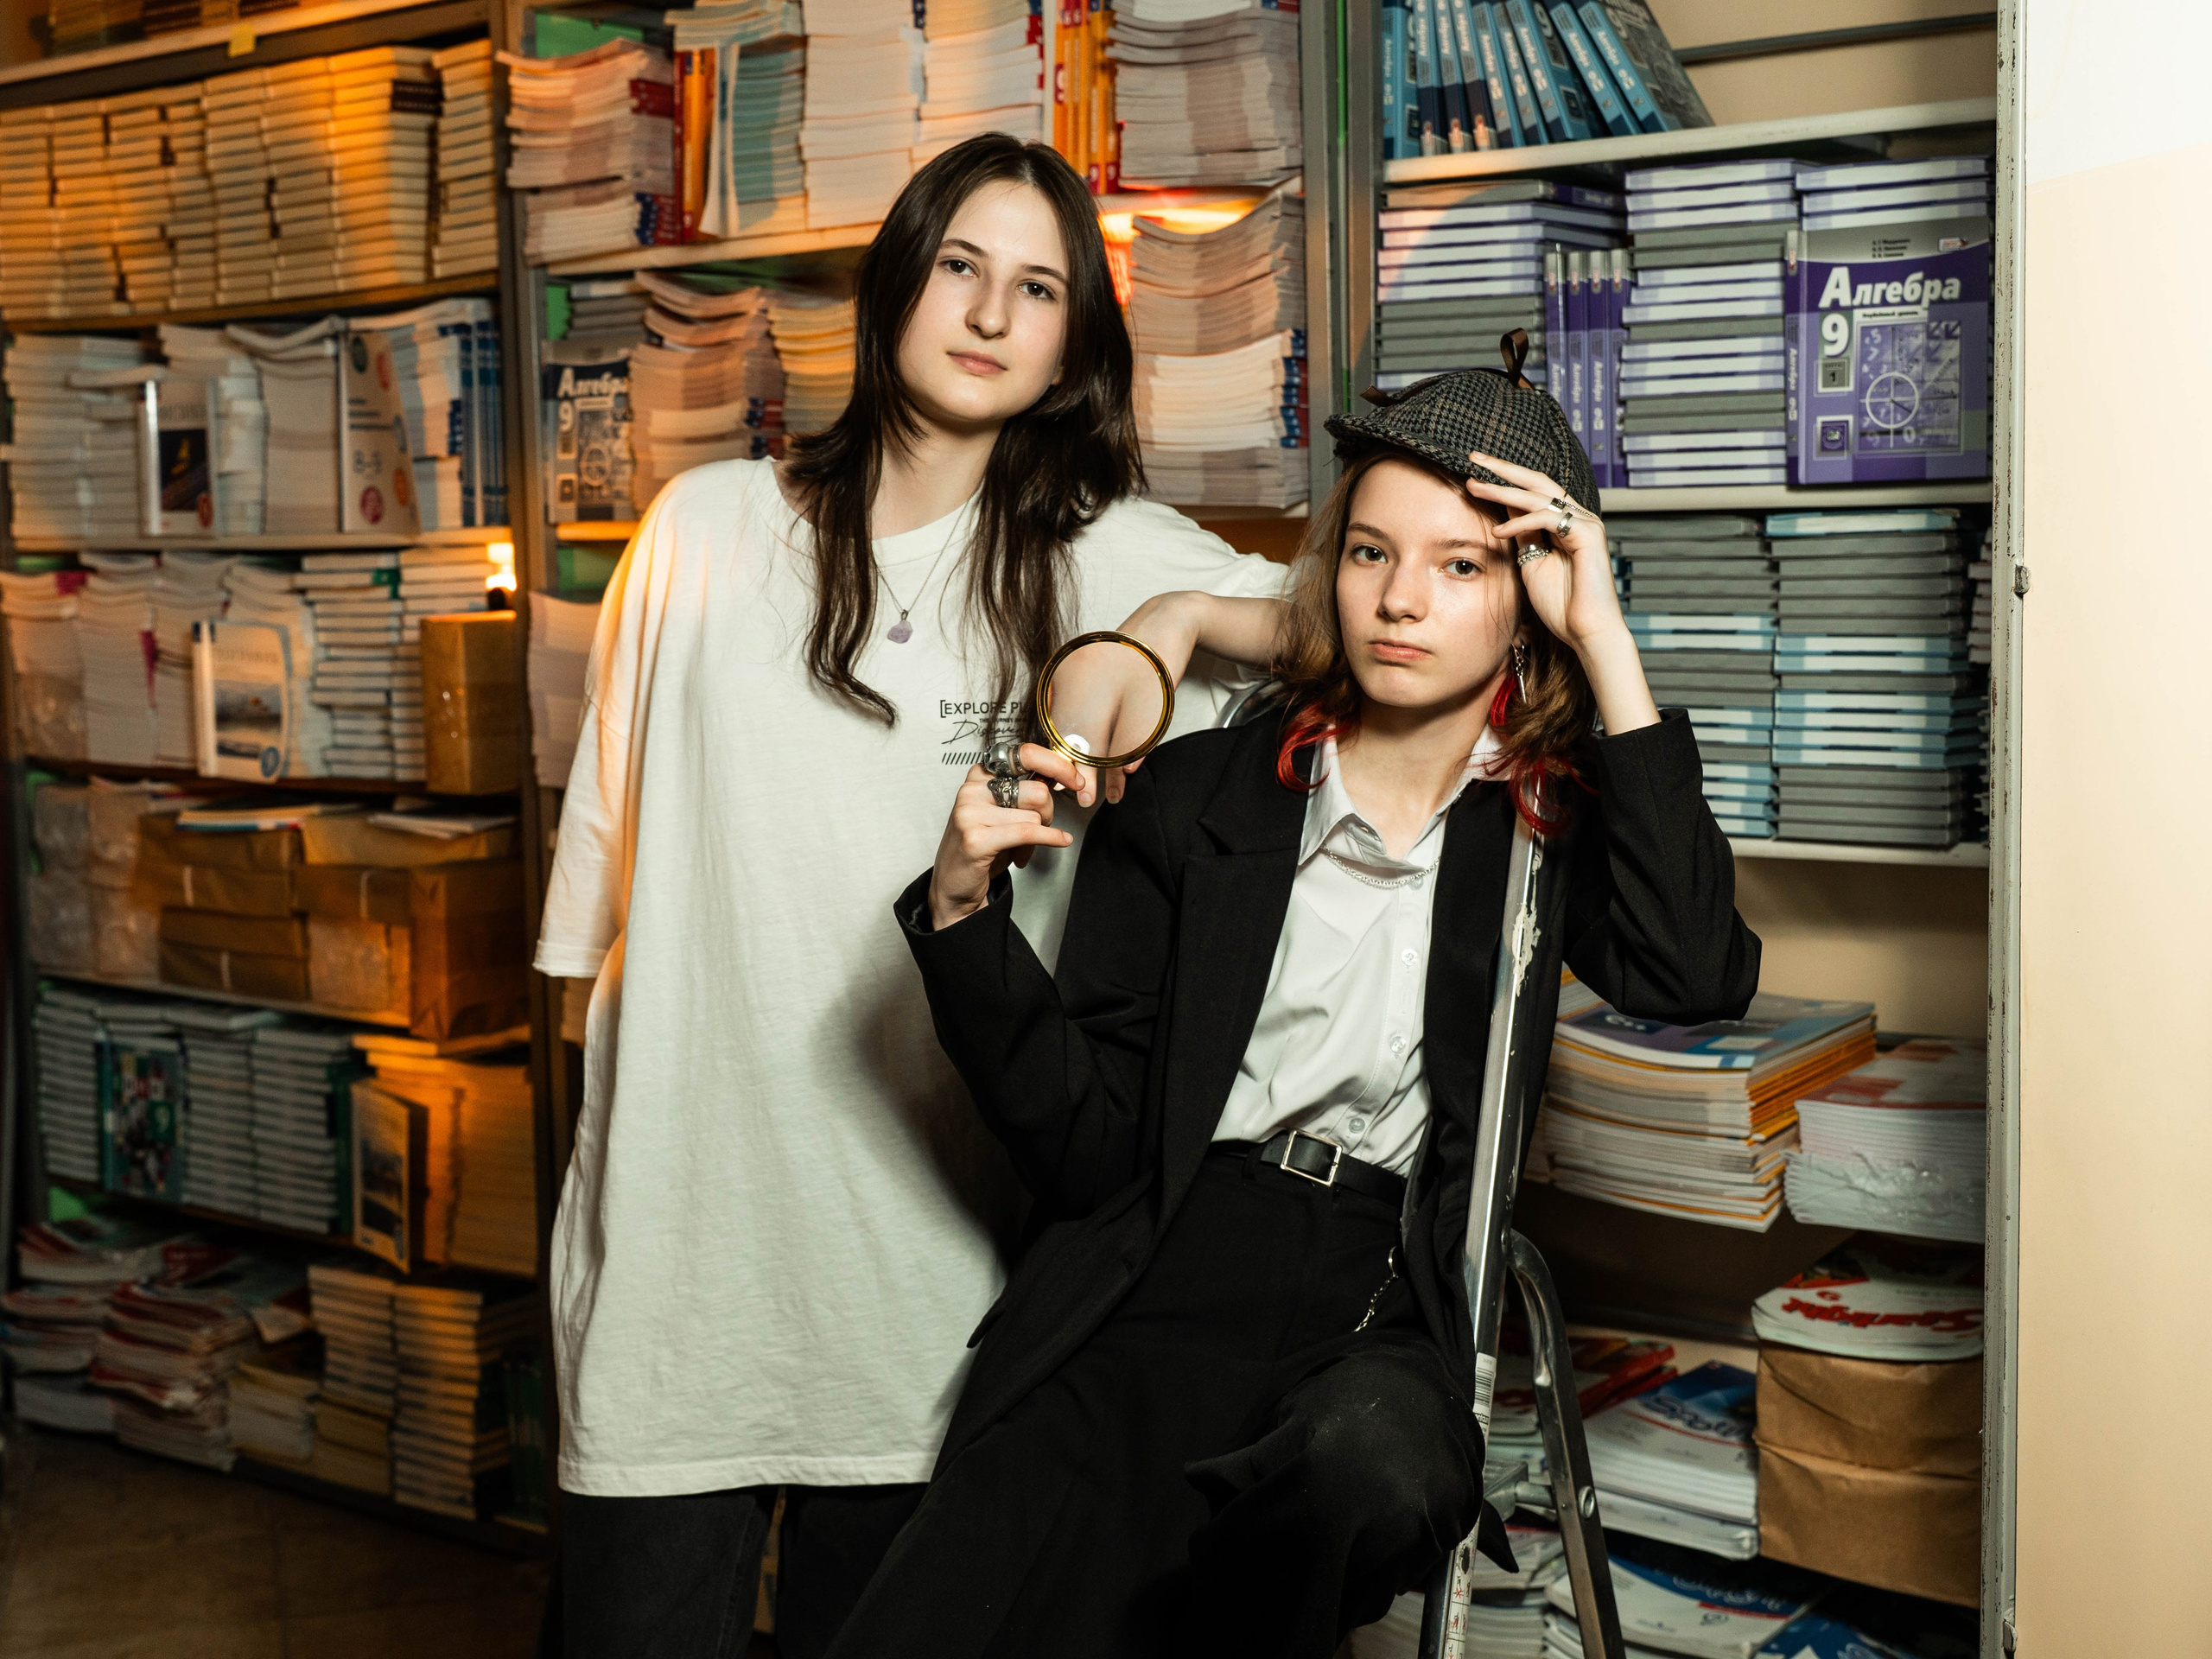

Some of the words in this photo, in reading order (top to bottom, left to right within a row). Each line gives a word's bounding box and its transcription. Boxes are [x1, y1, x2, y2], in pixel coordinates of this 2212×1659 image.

[1818, 265, 1961, 310] Алгебра
[1821, 313, 1849, 358] 9
[559, 400, 573, 432] 9
